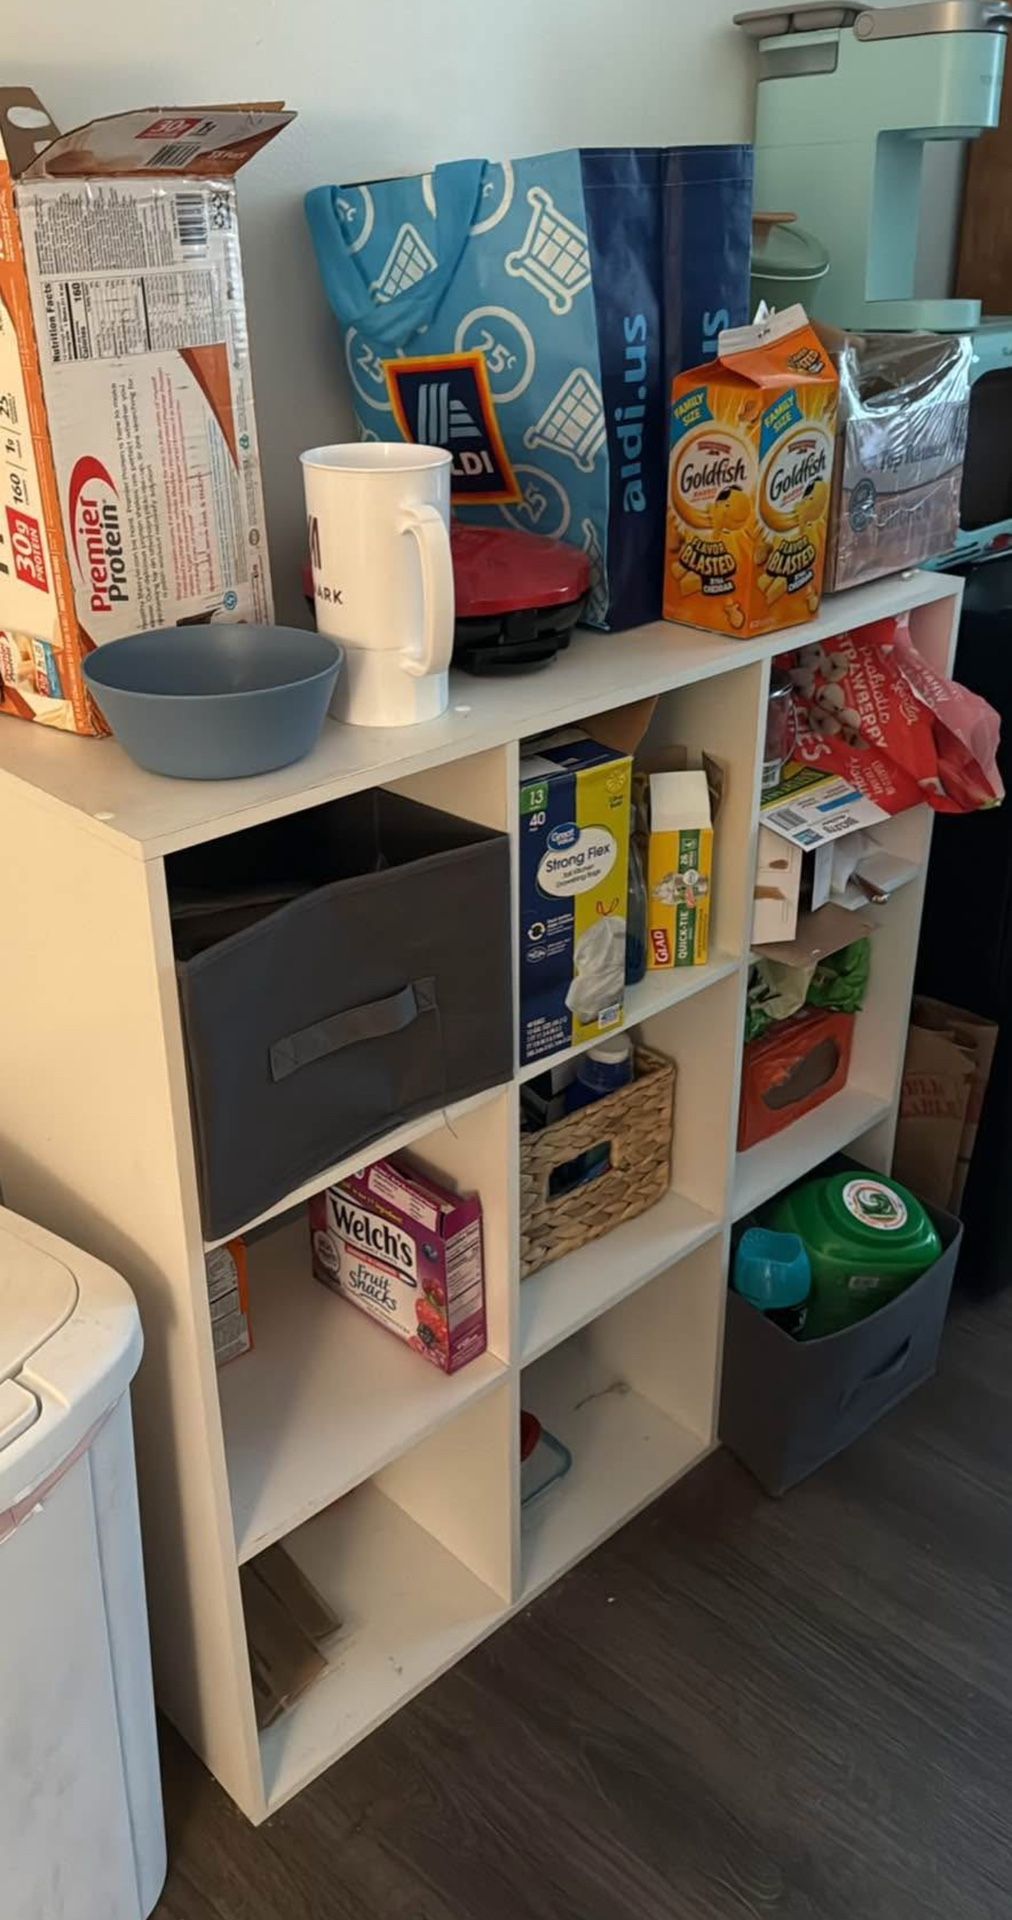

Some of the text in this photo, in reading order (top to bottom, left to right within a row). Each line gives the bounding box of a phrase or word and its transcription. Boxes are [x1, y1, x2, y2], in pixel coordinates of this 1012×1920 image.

[71, 282, 82, 303] 160
[44, 283, 62, 363] Nutrition Facts
[357, 344, 386, 383] 25
[615, 313, 649, 513] aldi.us
[674, 393, 705, 419] FAMILY
[682, 410, 702, 427] SIZE
[764, 394, 795, 428] FAMILY
[772, 411, 793, 433] SIZE
[448, 451, 494, 476] LDI
[681, 458, 747, 494] Goldfish
[770, 450, 826, 501] Goldfish
[10, 473, 24, 504] 160
[11, 519, 35, 578] 30g
[29, 527, 45, 583] PROTEIN
[88, 496, 113, 613] Premier
[107, 504, 129, 602] Protein
[680, 545, 736, 576] BLASTED
[691, 537, 725, 555] FLAVOR
[767, 545, 816, 576] BLASTED
[780, 536, 810, 553] FLAVOR
[530, 789, 544, 805] 13
[529, 811, 546, 826] 40
[546, 844, 611, 873] Strong Flex
[653, 930, 669, 963] GLAD
[677, 911, 688, 959] QUICK-TIE
[330, 1197, 413, 1267] Welch's
[349, 1270, 397, 1310] Snacks
[357, 1264, 391, 1290] Fruit
